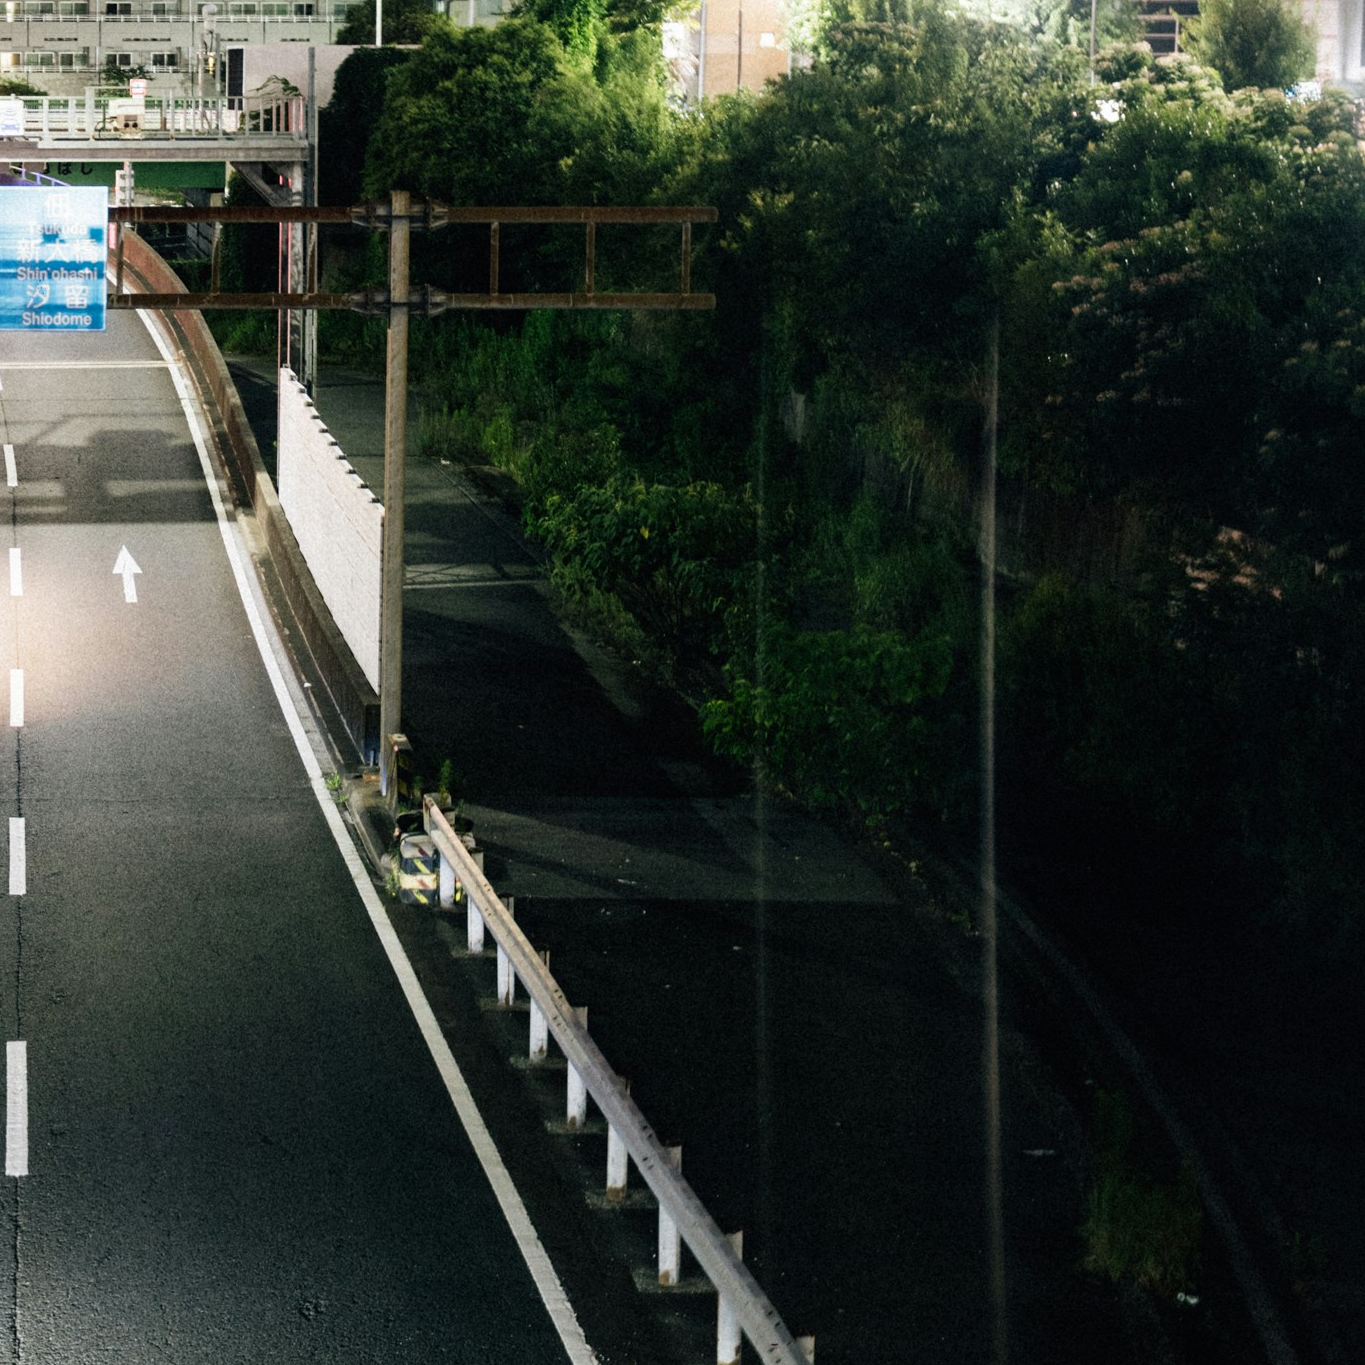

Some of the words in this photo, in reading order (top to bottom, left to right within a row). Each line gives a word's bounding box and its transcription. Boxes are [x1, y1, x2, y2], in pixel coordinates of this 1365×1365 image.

[29, 223, 86, 235] Tsukuda
[16, 238, 98, 264] 新大橋
[26, 284, 90, 309] 汐留
[22, 312, 93, 326] Shiodome
